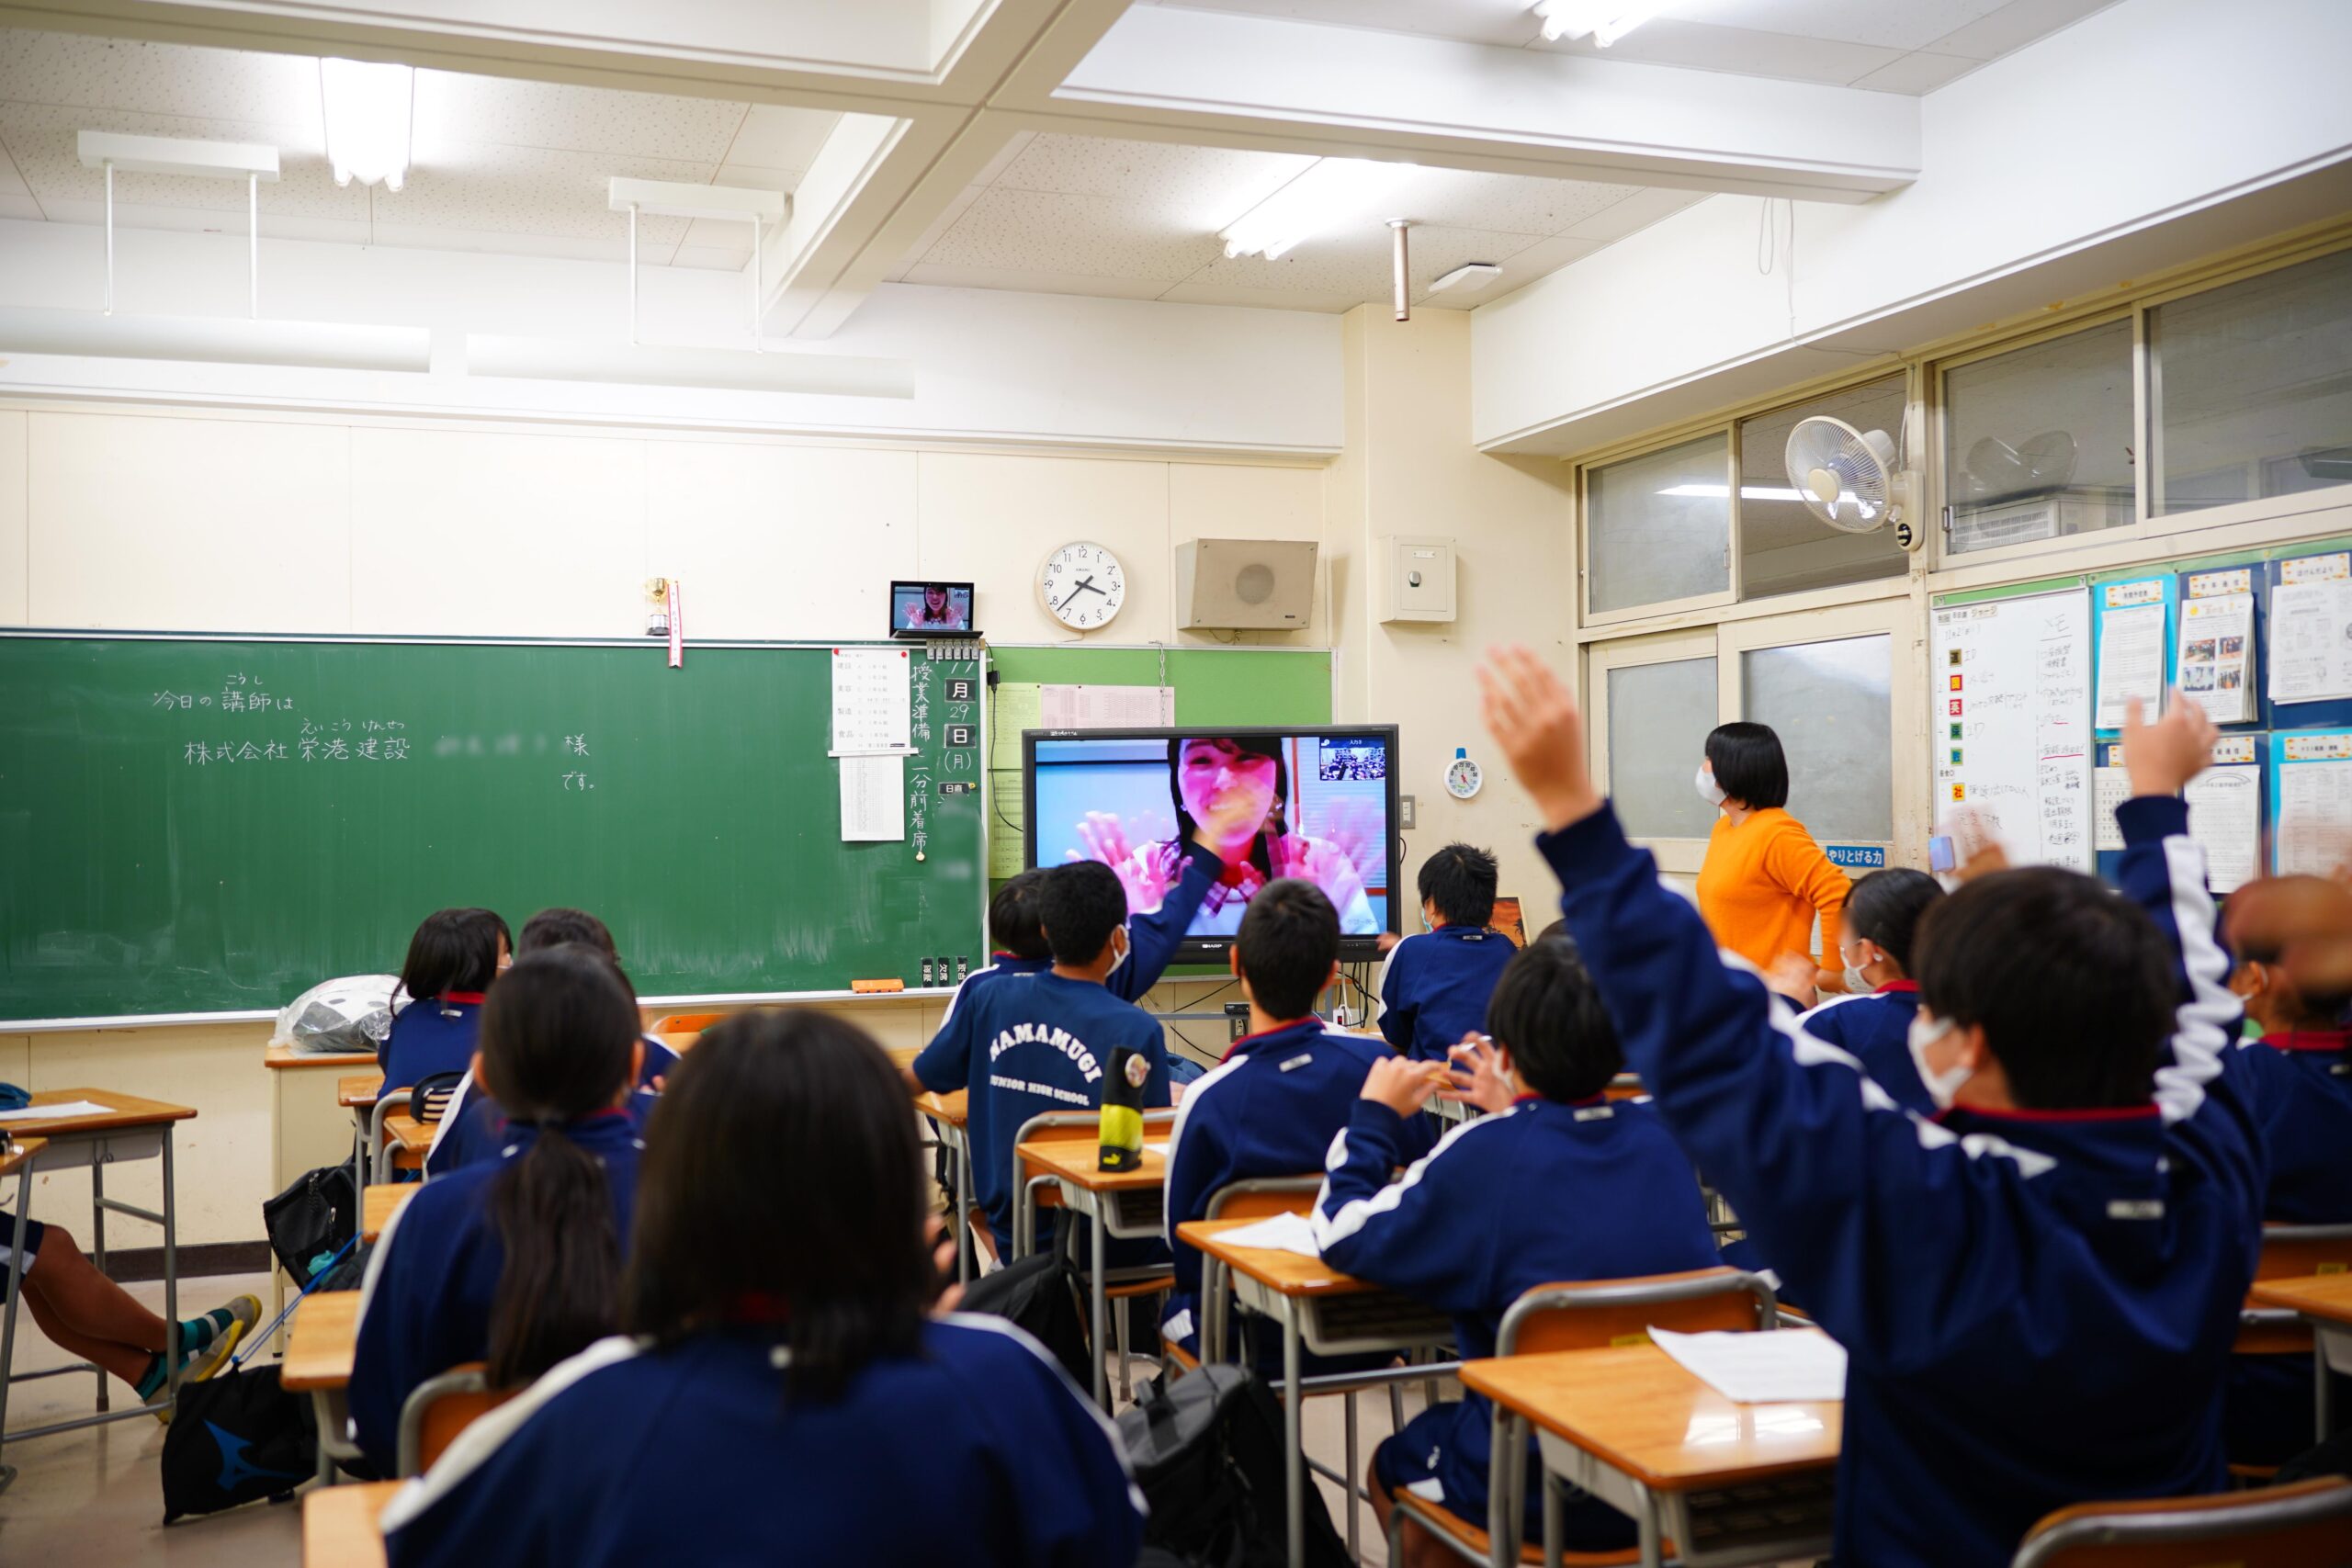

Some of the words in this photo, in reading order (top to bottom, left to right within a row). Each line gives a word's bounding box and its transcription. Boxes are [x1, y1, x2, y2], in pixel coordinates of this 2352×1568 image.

[1064, 553, 1071, 563] 11
[1079, 548, 1087, 558] 12
[1097, 554, 1100, 563] 1
[1053, 564, 1062, 574] 10
[1107, 566, 1113, 575] 2
[1047, 580, 1053, 589] 9
[1111, 581, 1117, 591] 3
[1052, 596, 1058, 605] 8
[1066, 608, 1072, 618] 7
[1080, 613, 1086, 622] 6
[1096, 609, 1102, 618] 5
[950, 662, 974, 674] 11
[225, 673, 264, 686] こうし
[952, 682, 969, 699] 月
[153, 685, 294, 713] 今日の講師は
[950, 704, 971, 722] 29
[1950, 701, 1960, 714] 英
[953, 728, 968, 744] 日
[564, 734, 590, 756] 様
[944, 751, 972, 774] (月)
[562, 772, 595, 791] です。
[1829, 849, 1882, 865] やりとげる力
[939, 963, 948, 981] 欠席
[1027, 1082, 1053, 1097] HIGH
[1054, 1089, 1090, 1107] SCHOOL
